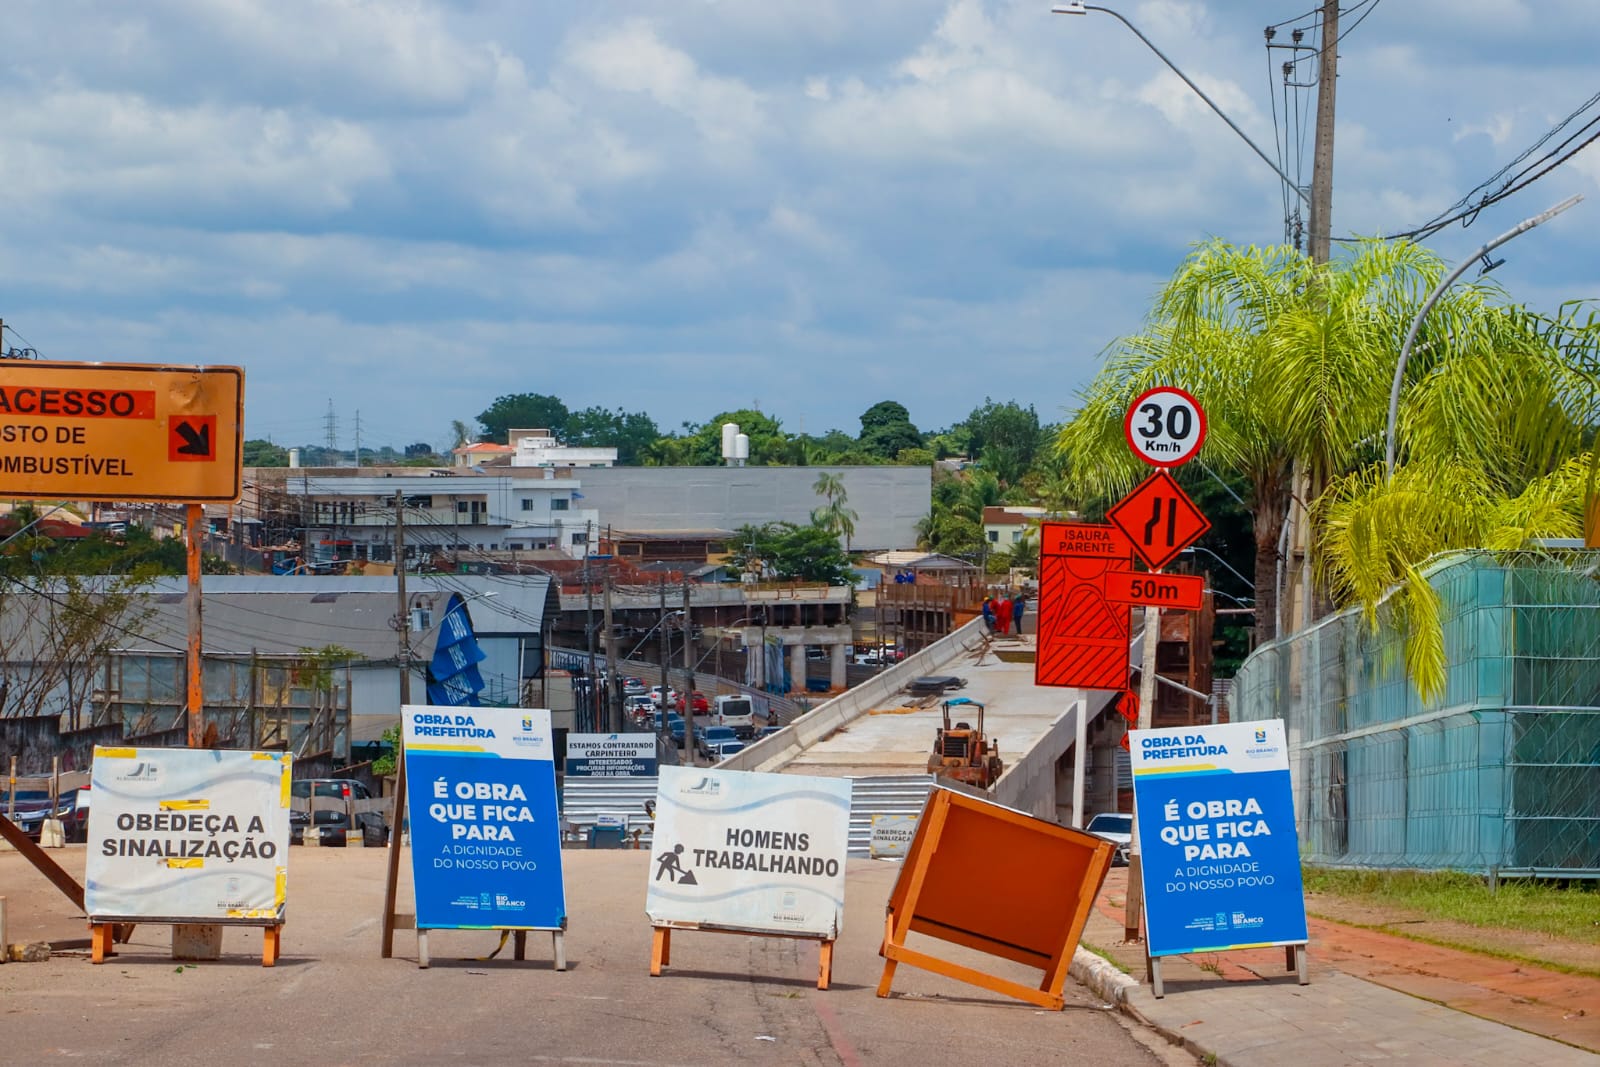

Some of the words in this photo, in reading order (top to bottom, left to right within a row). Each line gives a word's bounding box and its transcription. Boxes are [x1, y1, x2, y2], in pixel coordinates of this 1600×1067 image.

[1138, 403, 1192, 440] 30
[0, 425, 48, 443] STO
[56, 426, 86, 444] DE
[1145, 440, 1181, 453] Km/h
[0, 454, 134, 476] MBUSTÍVEL
[1064, 529, 1111, 541] ISAURA
[1059, 541, 1115, 553] PARENTE
[1130, 579, 1178, 600] 50m
[413, 714, 453, 726] OBRA
[455, 715, 475, 727] DA
[414, 726, 496, 739] PREFEITURA
[1141, 736, 1181, 748] OBRA
[1185, 735, 1206, 745] DA
[585, 750, 637, 758] CARPINTEIRO
[1143, 745, 1228, 760] PREFEITURA
[433, 776, 449, 799] É
[455, 782, 527, 801] OBRA
[429, 804, 476, 822] QUE
[483, 805, 535, 823] FICA
[1164, 799, 1180, 822] É
[1187, 798, 1263, 819] OBRA
[117, 813, 239, 837] OBEDEÇA
[246, 815, 264, 833] A
[452, 824, 515, 842] PARA
[1160, 825, 1210, 846] QUE
[1216, 820, 1271, 839] FICA
[726, 828, 809, 851] HOMENS
[102, 837, 277, 863] SINALIZAÇÃO
[442, 845, 451, 854] A
[454, 845, 522, 857] DIGNIDADE
[1184, 842, 1251, 862] PARA
[434, 859, 453, 869] DO
[456, 859, 498, 870] NOSSO
[502, 861, 537, 871] POVO
[693, 849, 839, 877] TRABALHANDO
[1174, 868, 1184, 878] A
[1187, 861, 1260, 877] DIGNIDADE
[1166, 882, 1186, 893] DO
[1189, 878, 1234, 891] NOSSO
[1238, 875, 1275, 887] POVO
